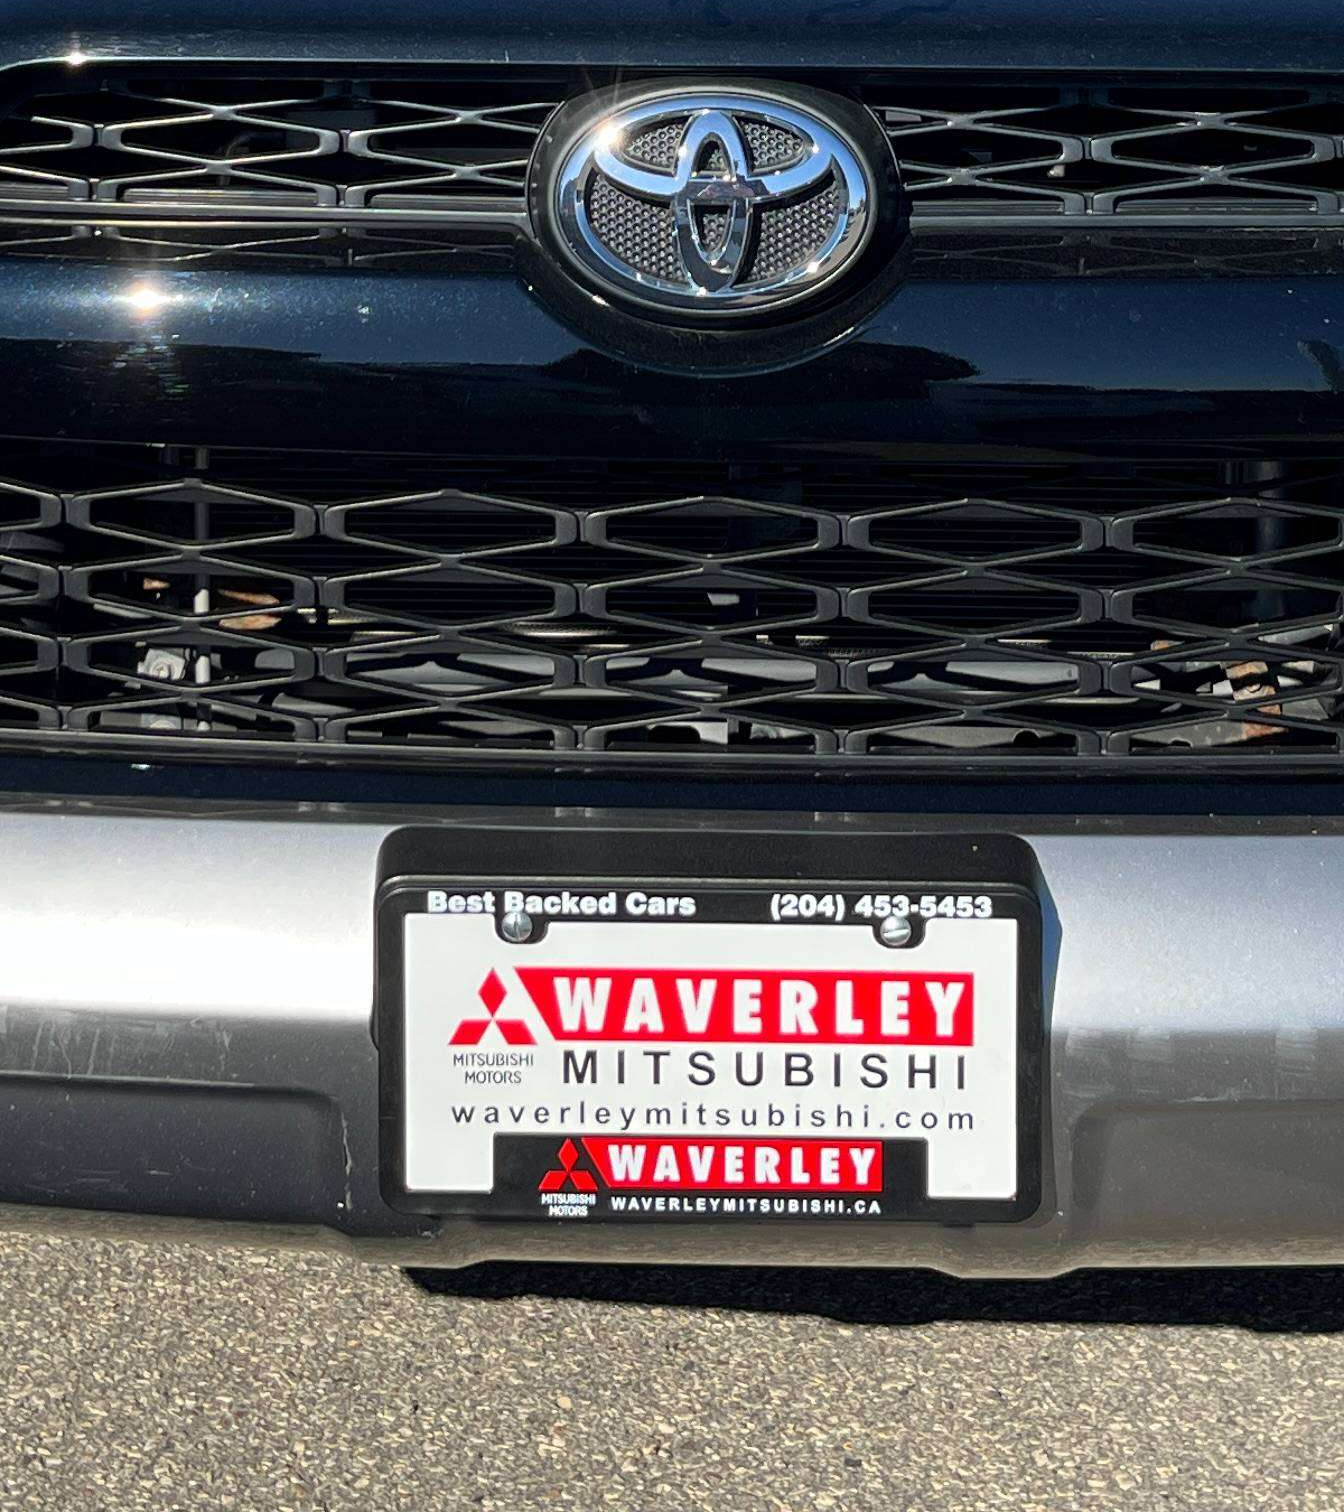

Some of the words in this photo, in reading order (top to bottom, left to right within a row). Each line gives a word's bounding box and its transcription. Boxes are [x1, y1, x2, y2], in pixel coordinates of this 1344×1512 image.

[427, 890, 495, 914] Best
[504, 890, 617, 915] Backed
[625, 892, 697, 916] Cars
[771, 893, 846, 921] (204)
[854, 895, 993, 918] 453-5453
[554, 977, 966, 1037] WAVERLEY
[453, 1053, 534, 1067] MITSUBISHI
[562, 1049, 966, 1091] MITSUBISHI
[464, 1070, 522, 1084] MOTORS
[451, 1100, 974, 1131] waverleymitsubishi.com
[608, 1144, 876, 1185] WAVERLEY
[541, 1193, 596, 1206] MITSUBISHI
[548, 1205, 588, 1217] MOTORS
[610, 1197, 882, 1215] WAVERLEYMITSUBISHI.CA
